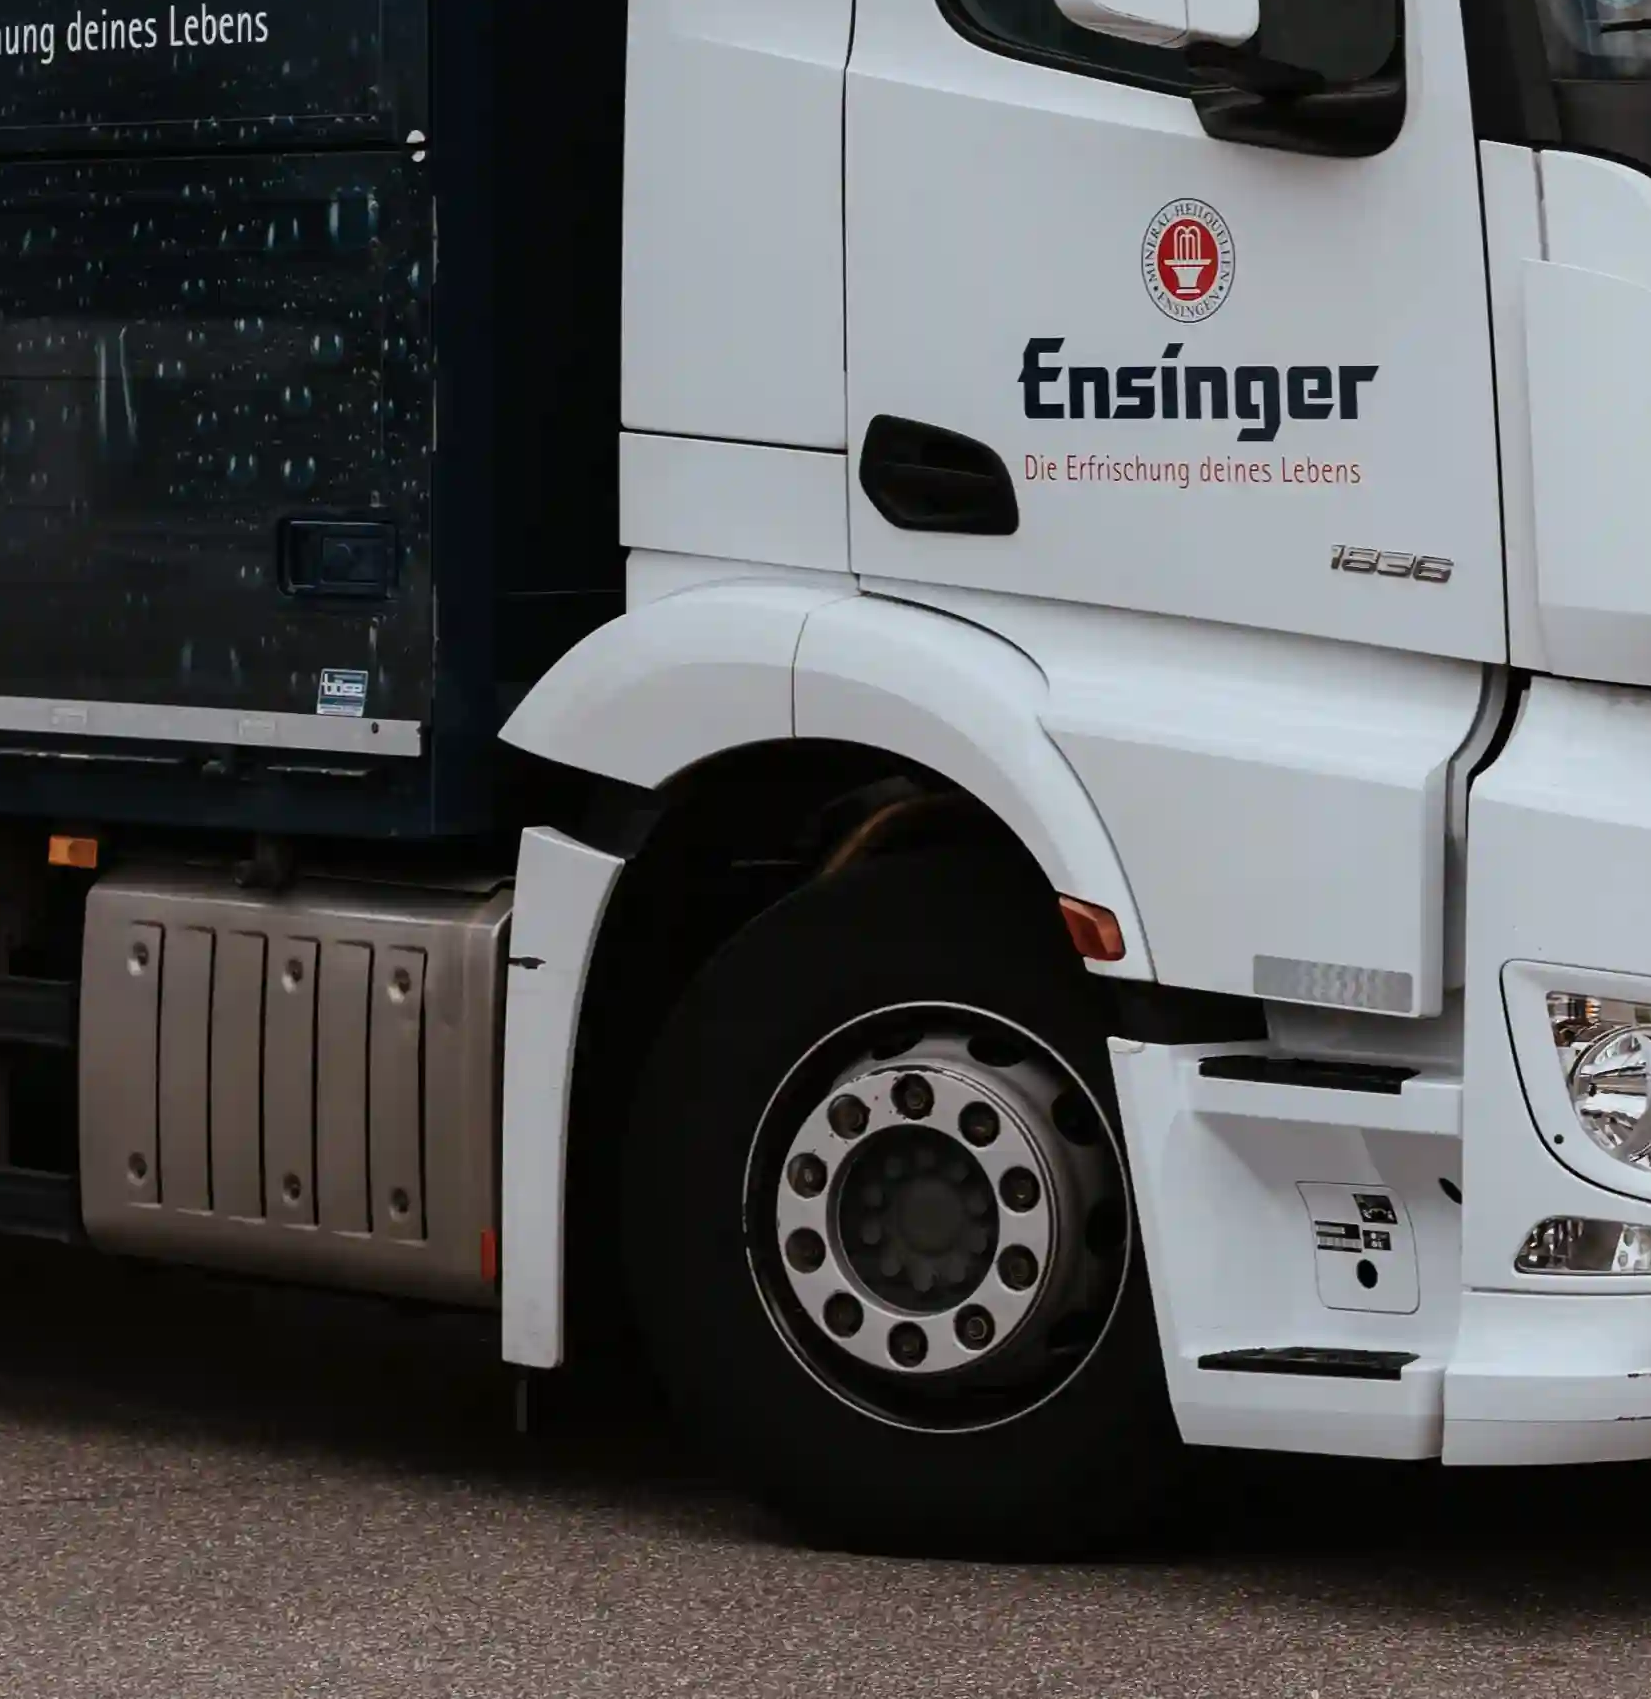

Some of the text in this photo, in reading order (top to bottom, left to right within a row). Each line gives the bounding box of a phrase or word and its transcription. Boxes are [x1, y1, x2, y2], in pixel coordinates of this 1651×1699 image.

[67, 9, 157, 52] deines
[170, 3, 268, 47] Lebens
[1018, 337, 1379, 442] Ensinger
[1025, 454, 1361, 488] Die Erfrischung deines Lebens
